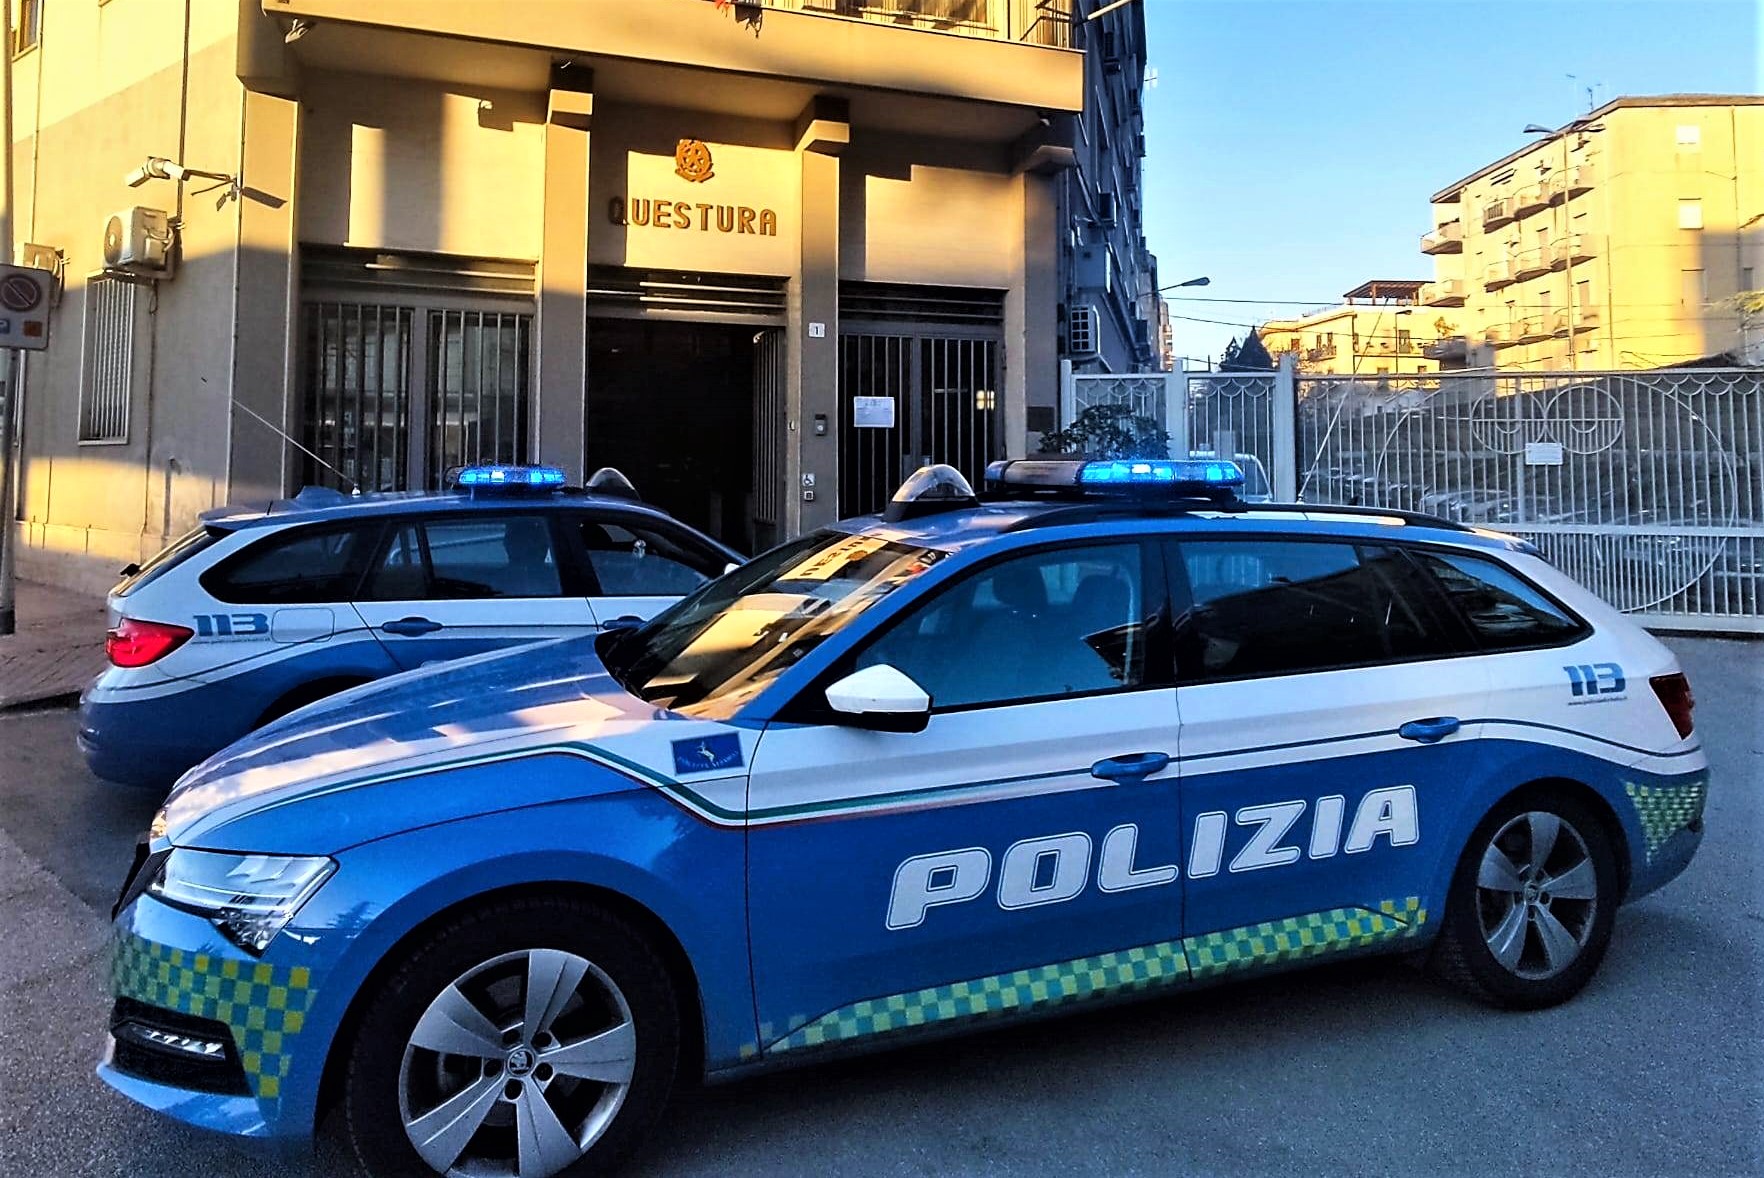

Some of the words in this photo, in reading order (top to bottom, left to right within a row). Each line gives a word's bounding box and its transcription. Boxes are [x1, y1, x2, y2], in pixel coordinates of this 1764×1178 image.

[608, 195, 777, 236] QUESTURA
[193, 613, 269, 636] 113
[1563, 662, 1626, 696] 113
[886, 785, 1420, 930] POLIZIA
